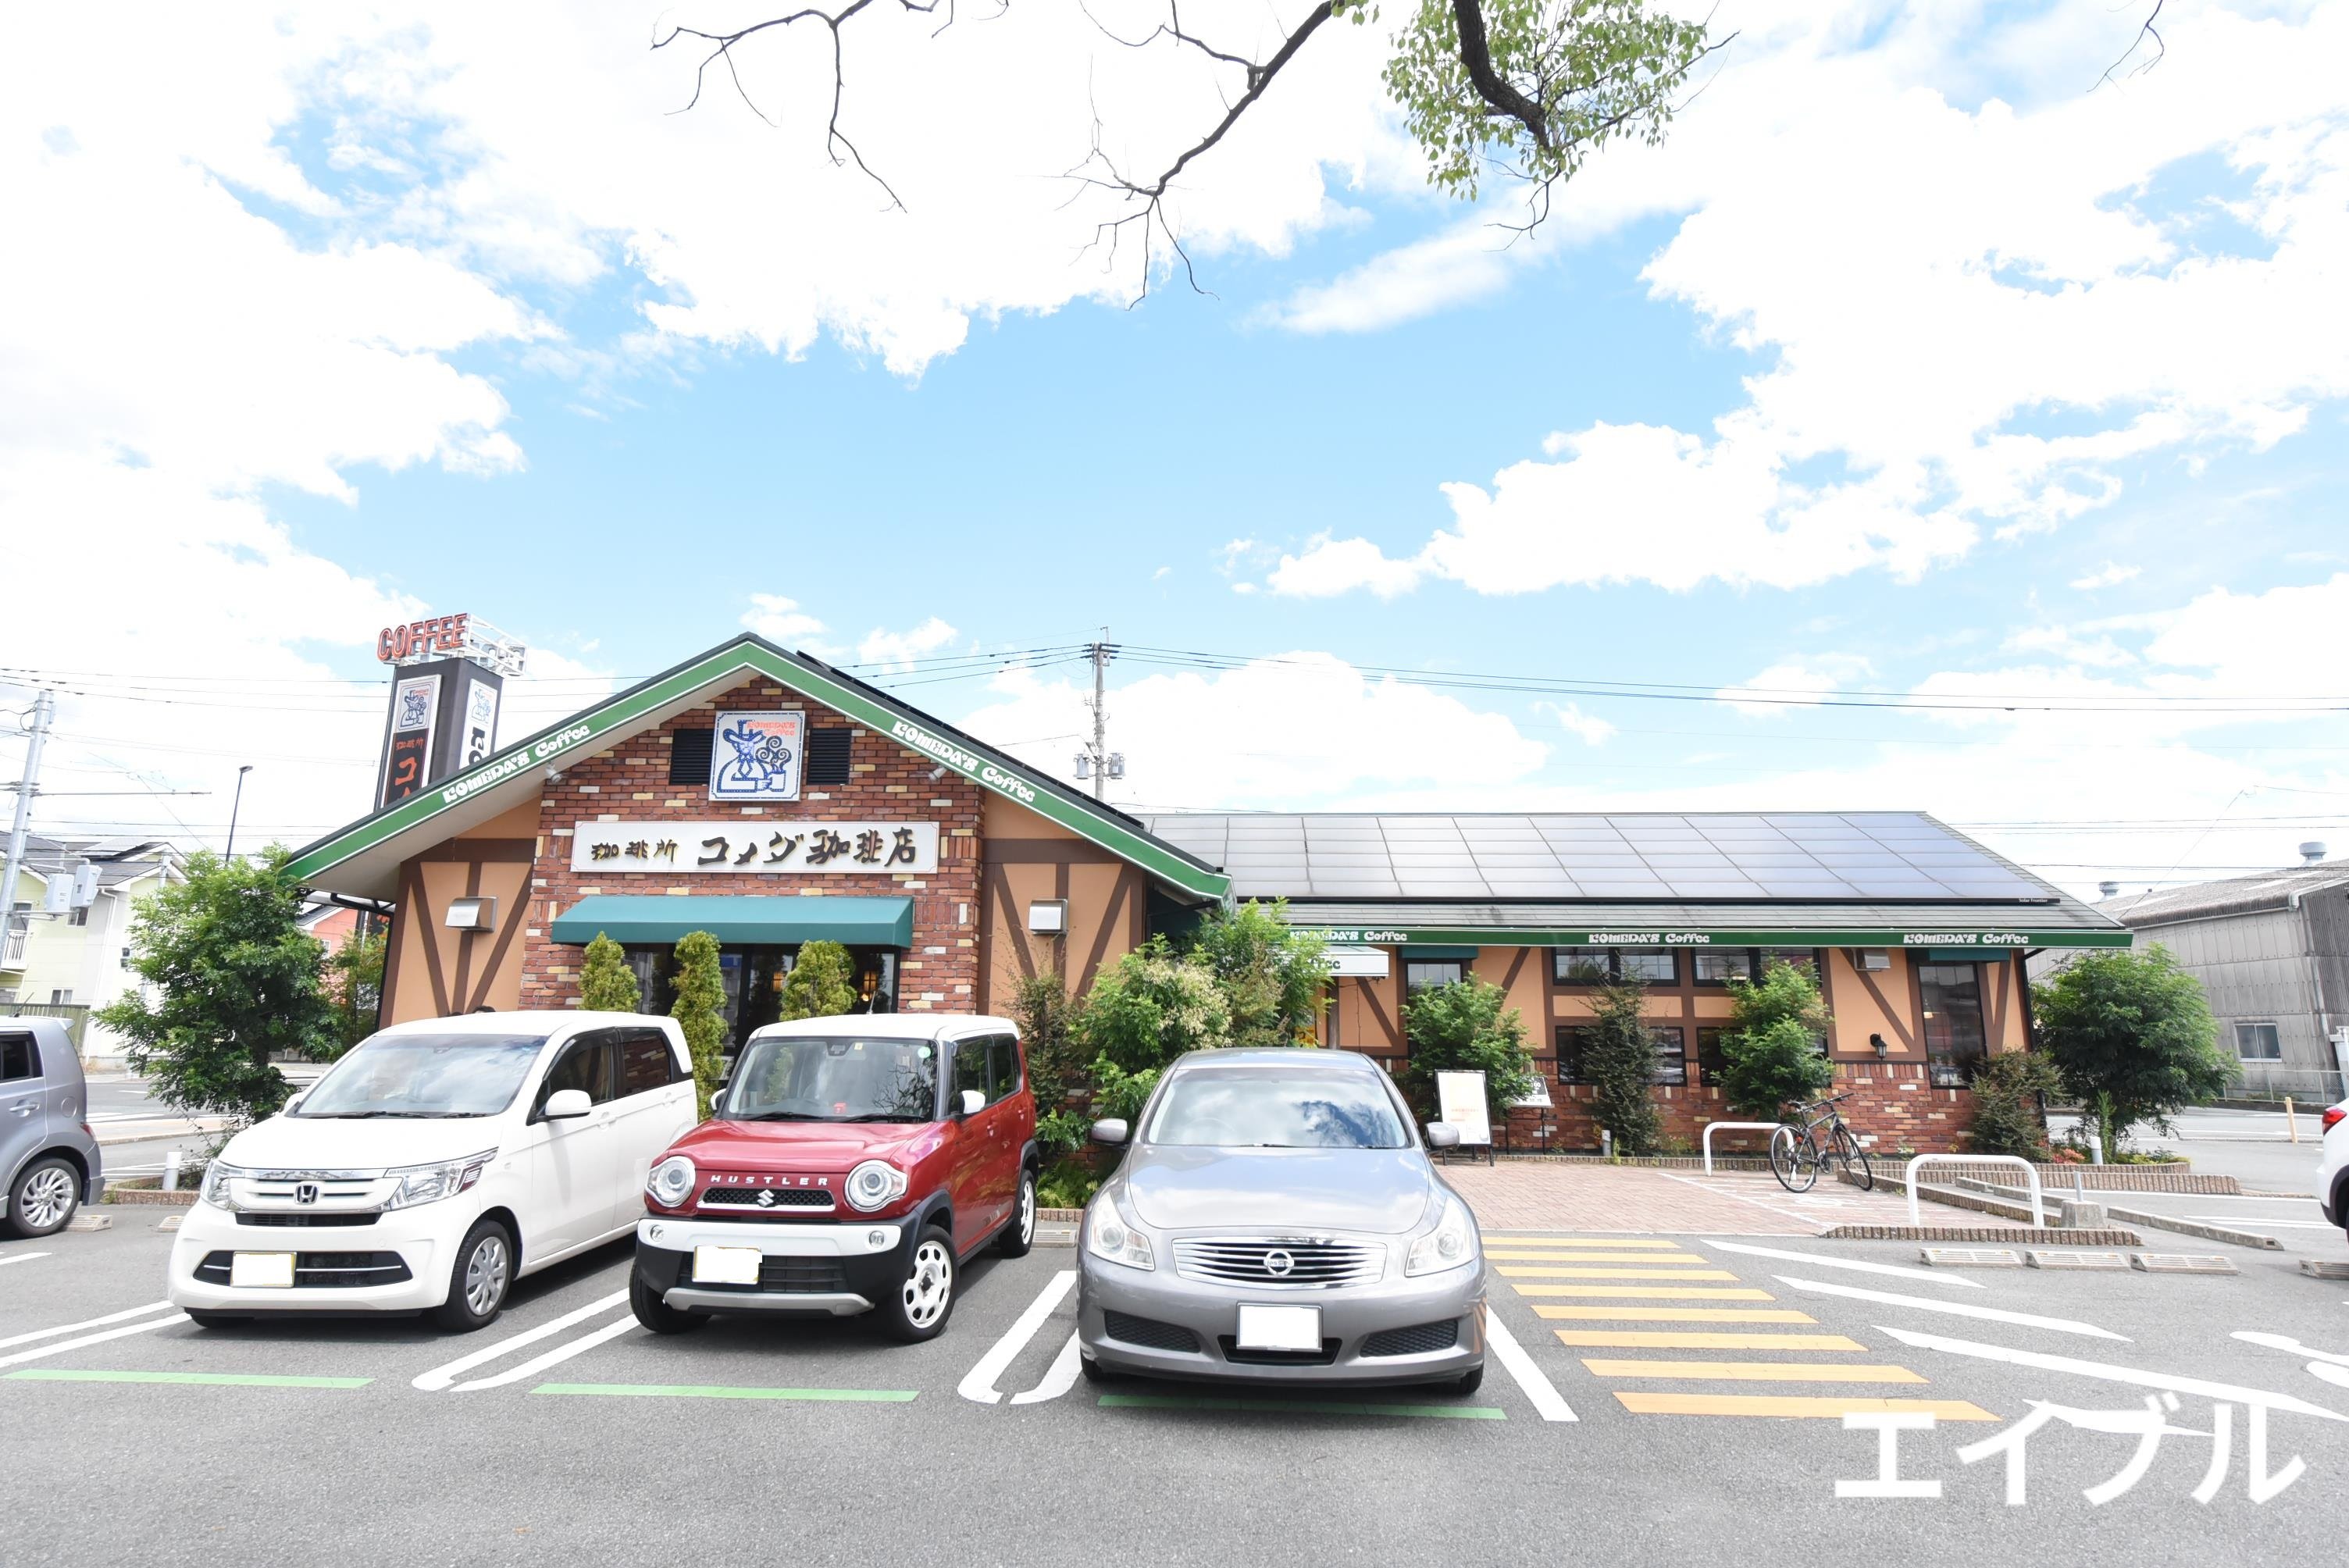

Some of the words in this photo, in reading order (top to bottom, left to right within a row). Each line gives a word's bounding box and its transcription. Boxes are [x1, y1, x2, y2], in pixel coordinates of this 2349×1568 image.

[377, 613, 467, 661] COFFEE
[442, 751, 530, 804] KOMEDA'S
[535, 725, 590, 757] Coffee
[892, 721, 978, 772] KOMEDA'S
[981, 767, 1035, 803] Coffee
[1364, 930, 1407, 942] Coffee
[1588, 933, 1660, 943] KOMEDA'S
[1665, 933, 1710, 943] Coffee
[1903, 934, 1977, 944] KOMEDA'S
[1982, 933, 2029, 944] Coffee
[711, 1174, 829, 1186] HUSTLER
